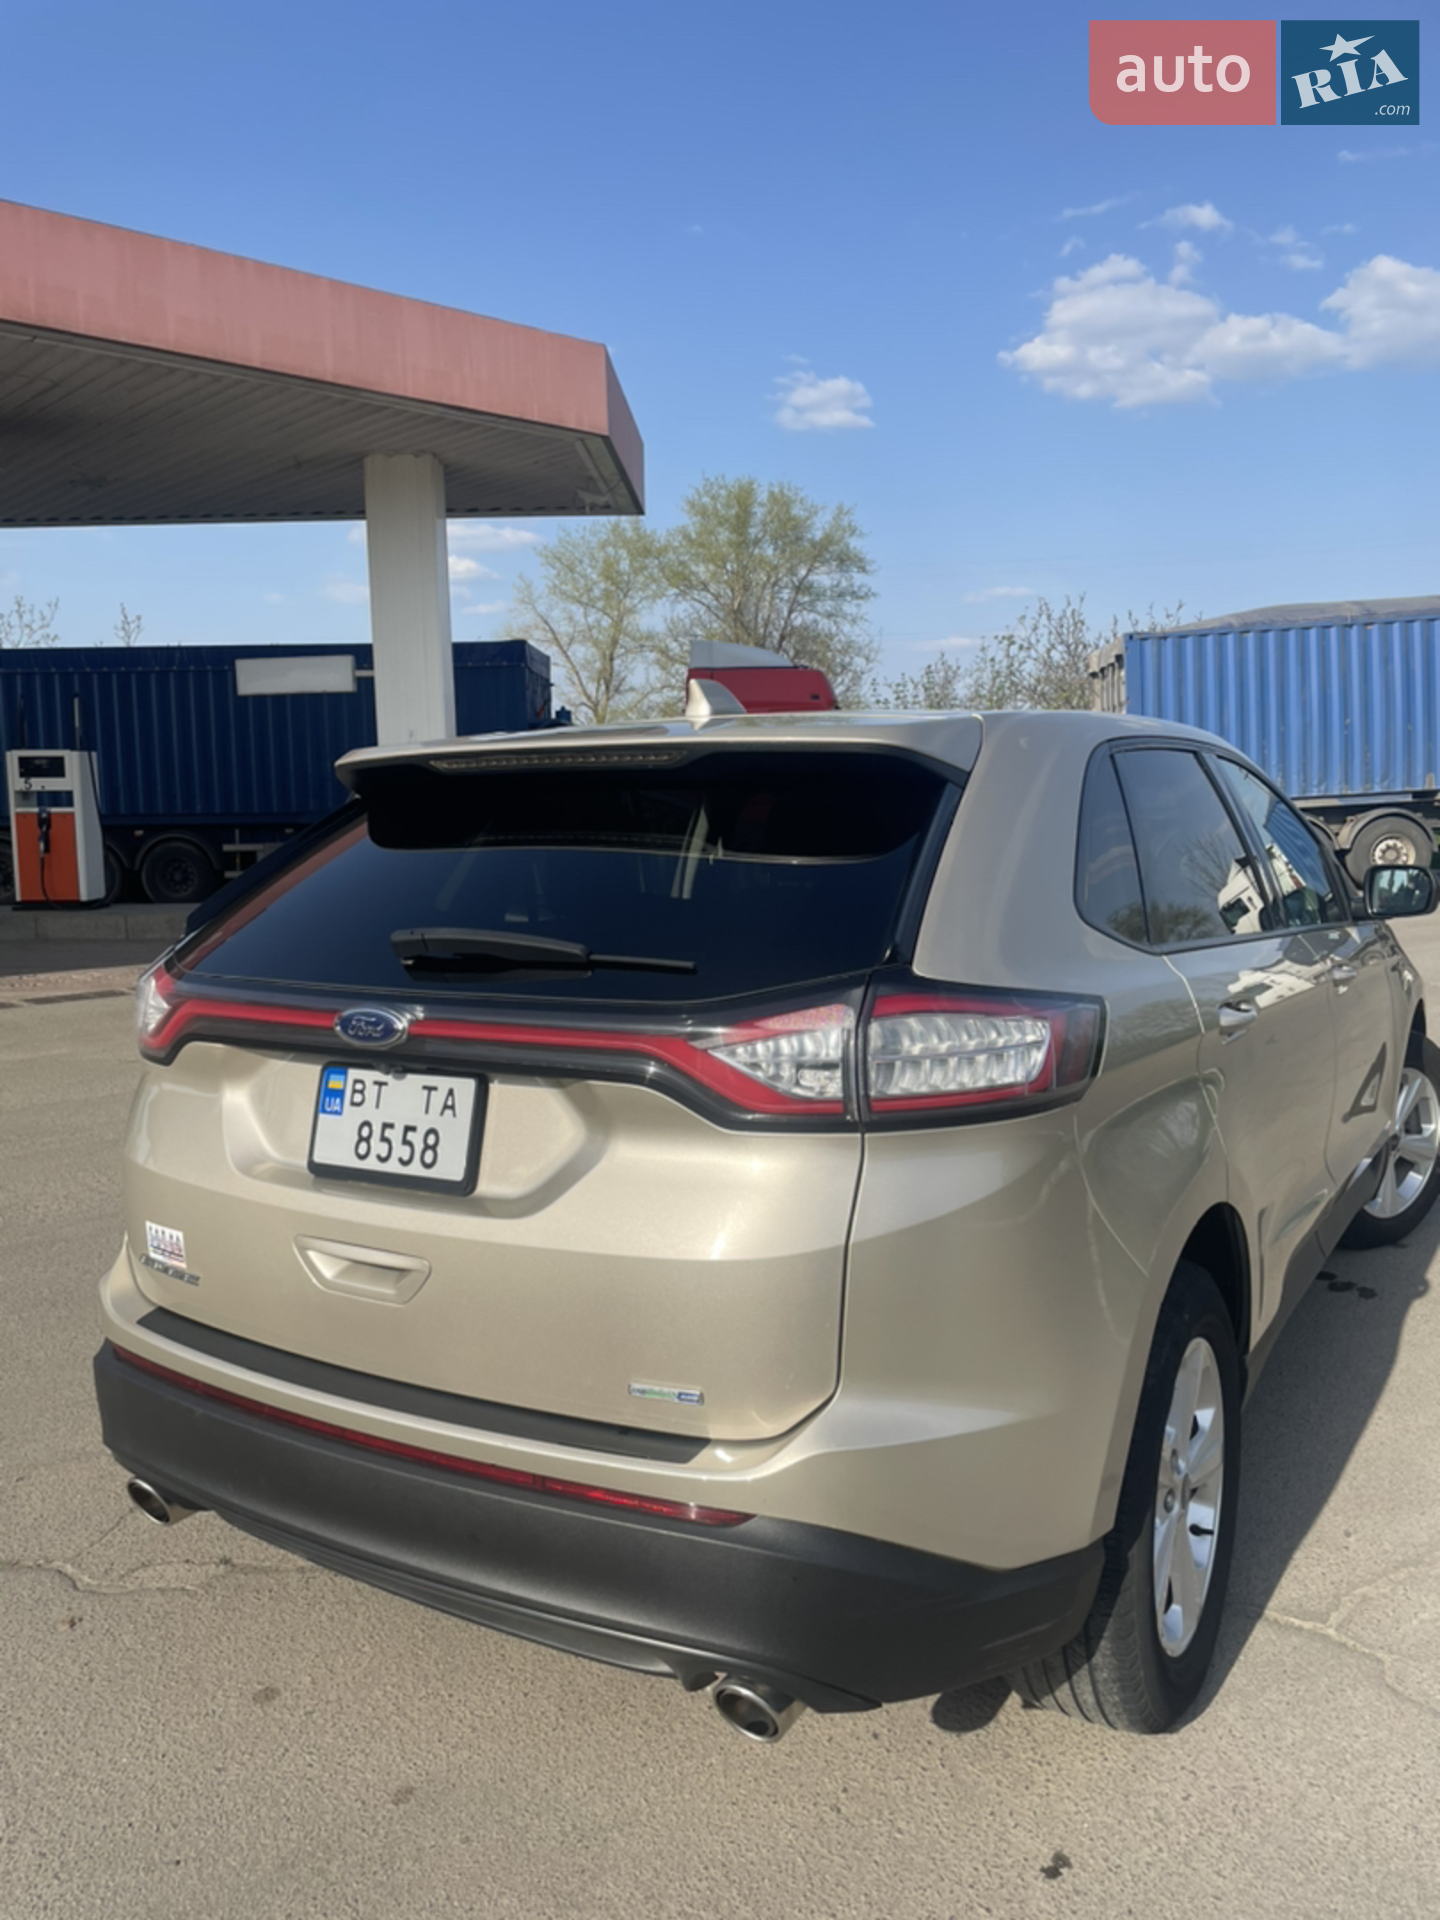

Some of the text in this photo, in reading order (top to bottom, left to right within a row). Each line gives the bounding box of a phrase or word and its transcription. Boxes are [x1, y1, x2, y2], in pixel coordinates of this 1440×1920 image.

[347, 1015, 385, 1038] Ford
[324, 1096, 341, 1113] UA
[350, 1078, 457, 1118] BT TA
[354, 1120, 440, 1170] 8558
